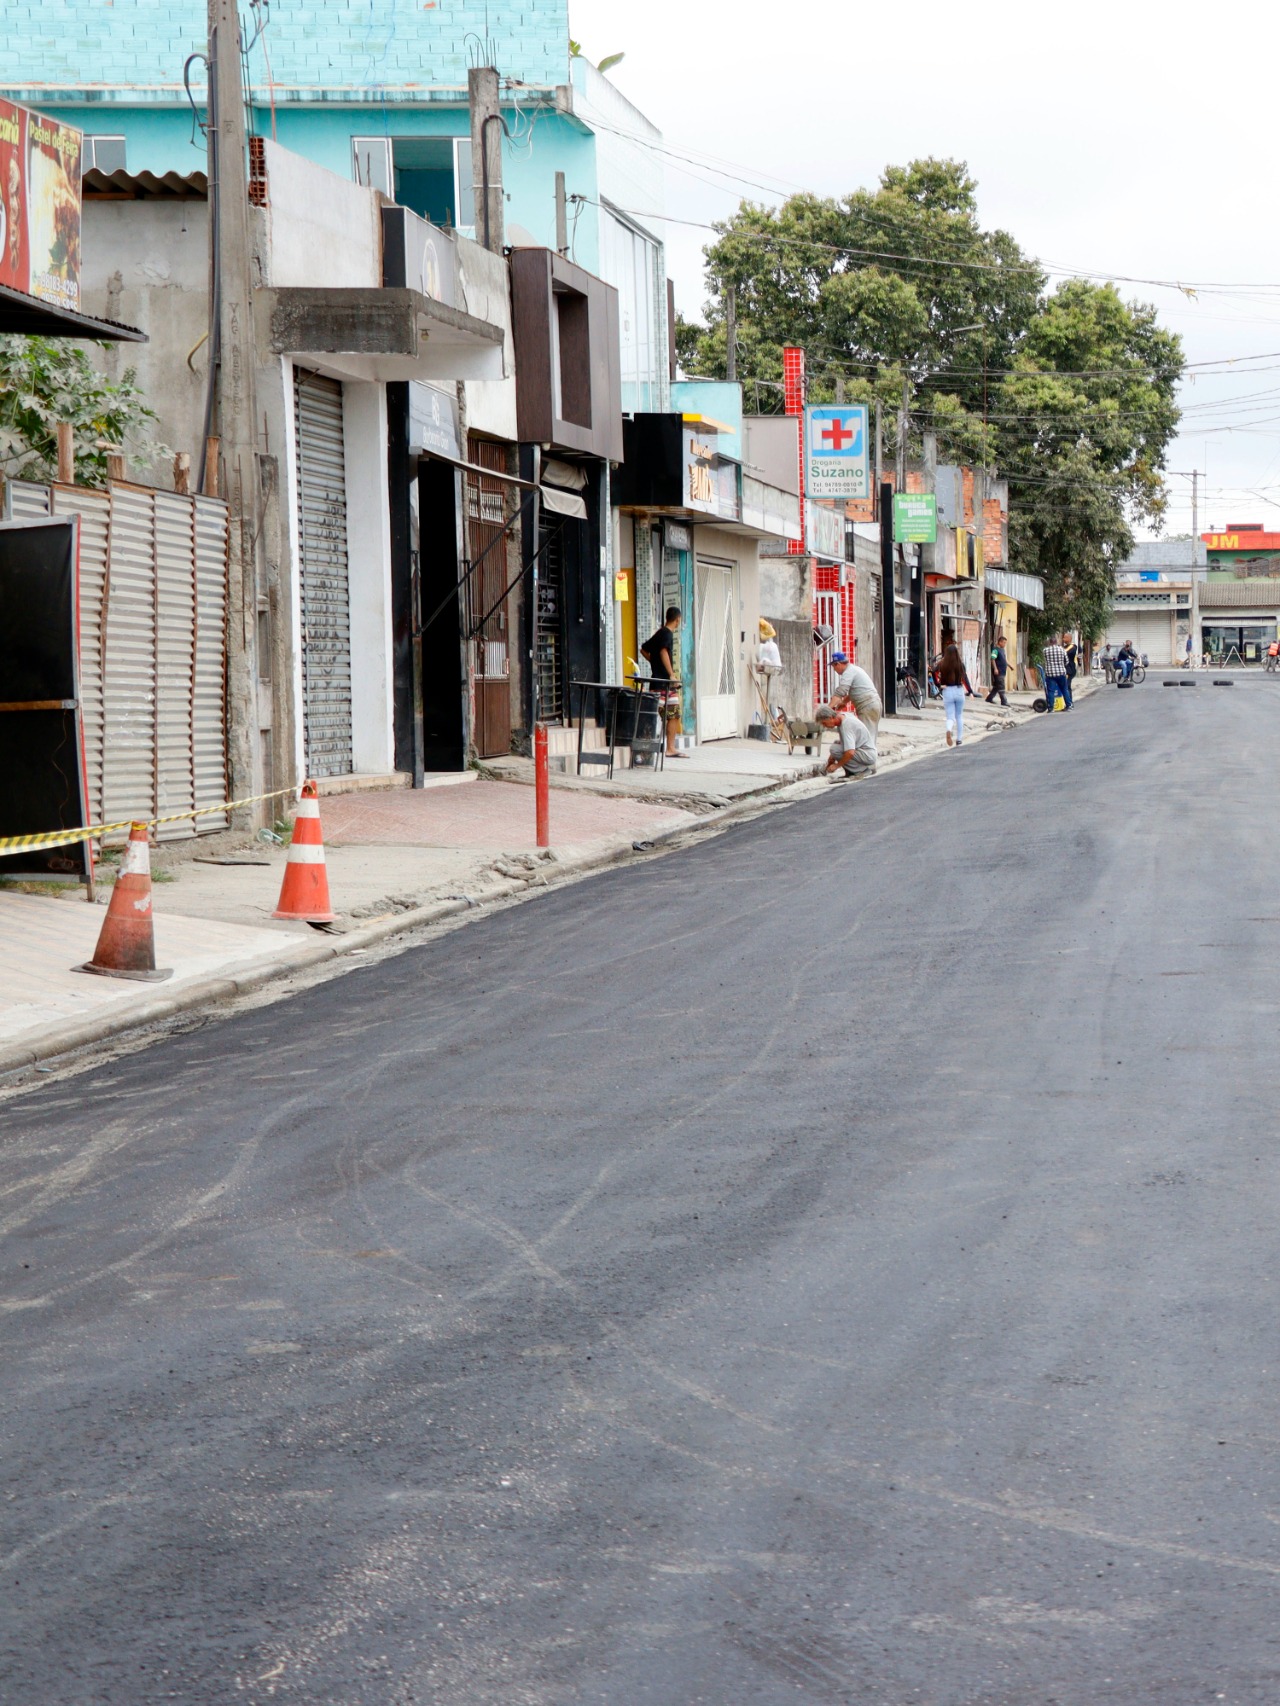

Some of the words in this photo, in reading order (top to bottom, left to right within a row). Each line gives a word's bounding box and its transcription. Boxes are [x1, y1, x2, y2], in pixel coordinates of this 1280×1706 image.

[29, 120, 51, 146] Pastel
[52, 130, 61, 149] de
[62, 135, 79, 157] Feira
[811, 459, 841, 467] Drogaria
[811, 466, 864, 478] Suzano
[1206, 534, 1239, 549] JM
